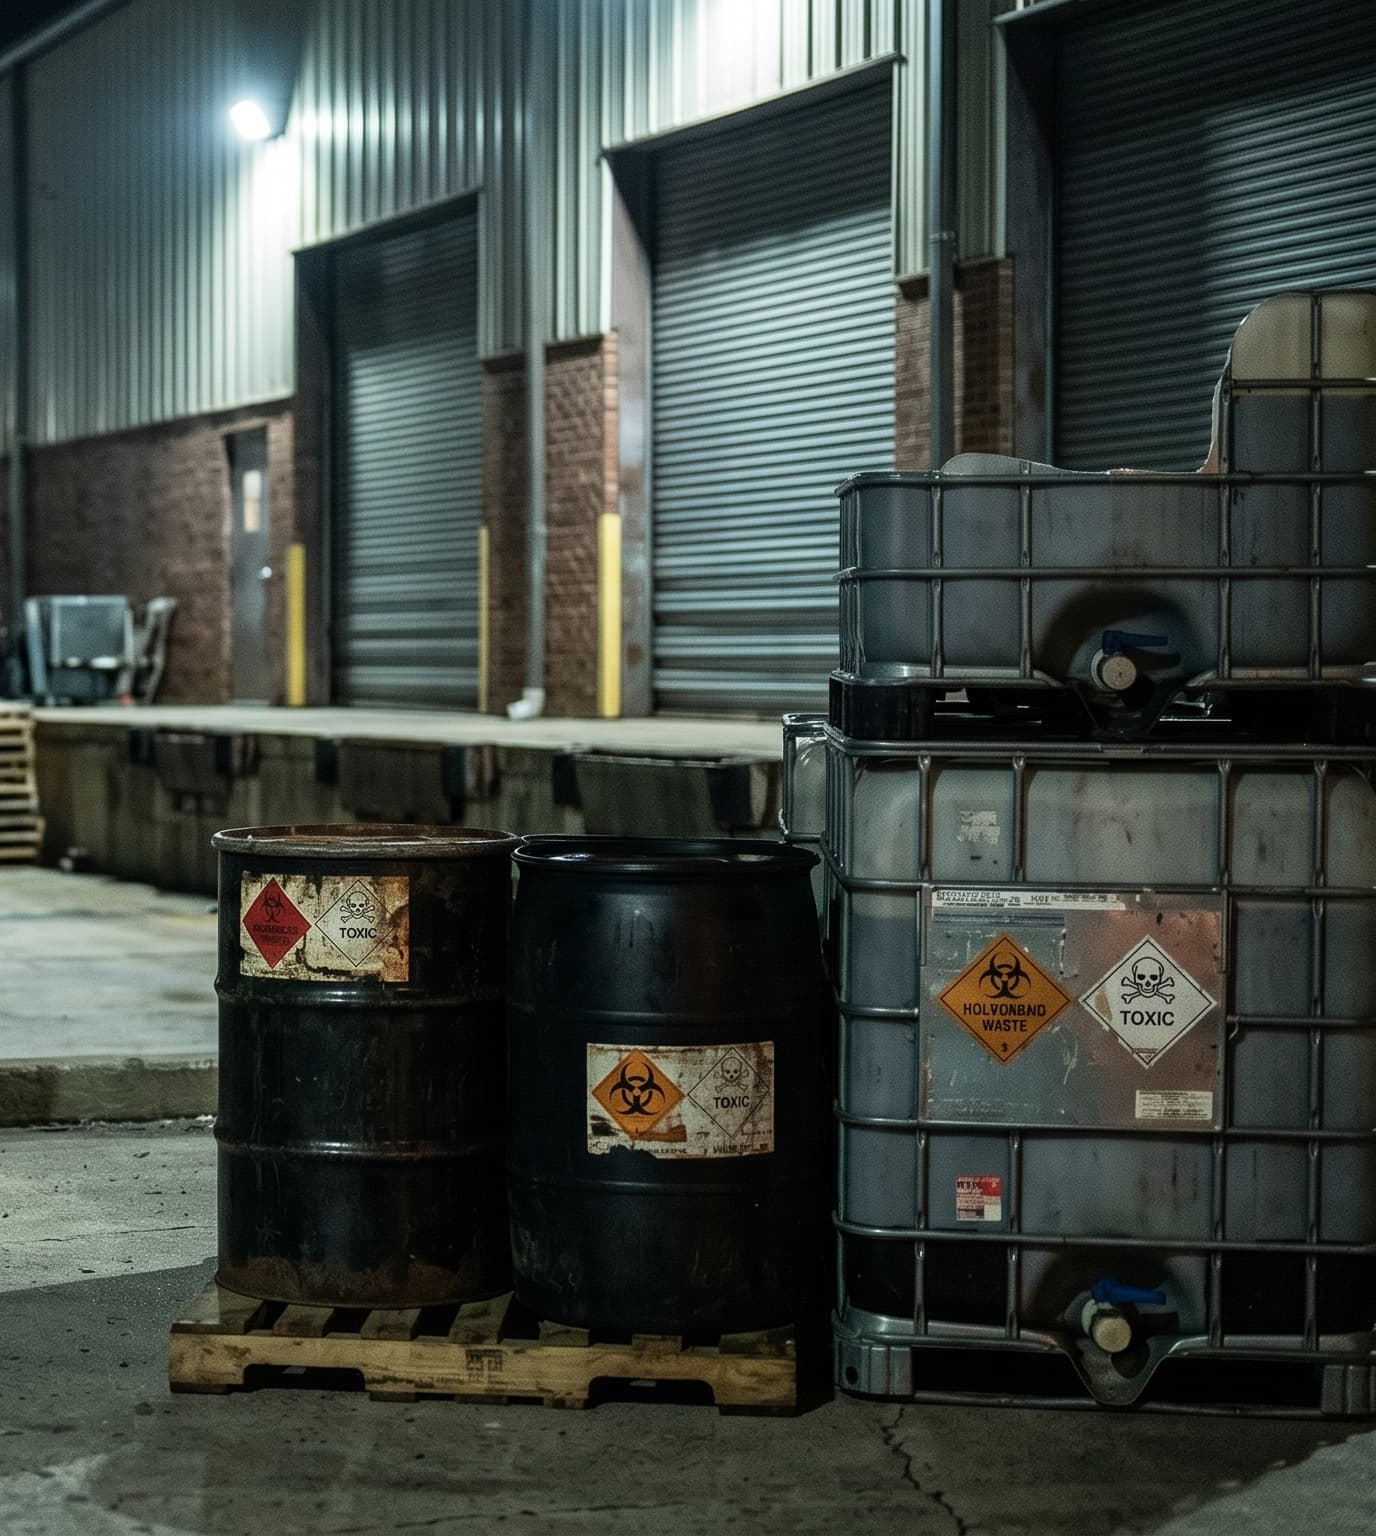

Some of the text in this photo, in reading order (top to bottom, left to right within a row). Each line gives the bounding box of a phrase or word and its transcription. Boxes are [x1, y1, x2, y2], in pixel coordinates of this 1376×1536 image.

[339, 927, 377, 939] TOXIC
[1120, 1010, 1175, 1027] TOXIC
[982, 1019, 1028, 1032] WASTE
[713, 1096, 750, 1110] TOXIC
